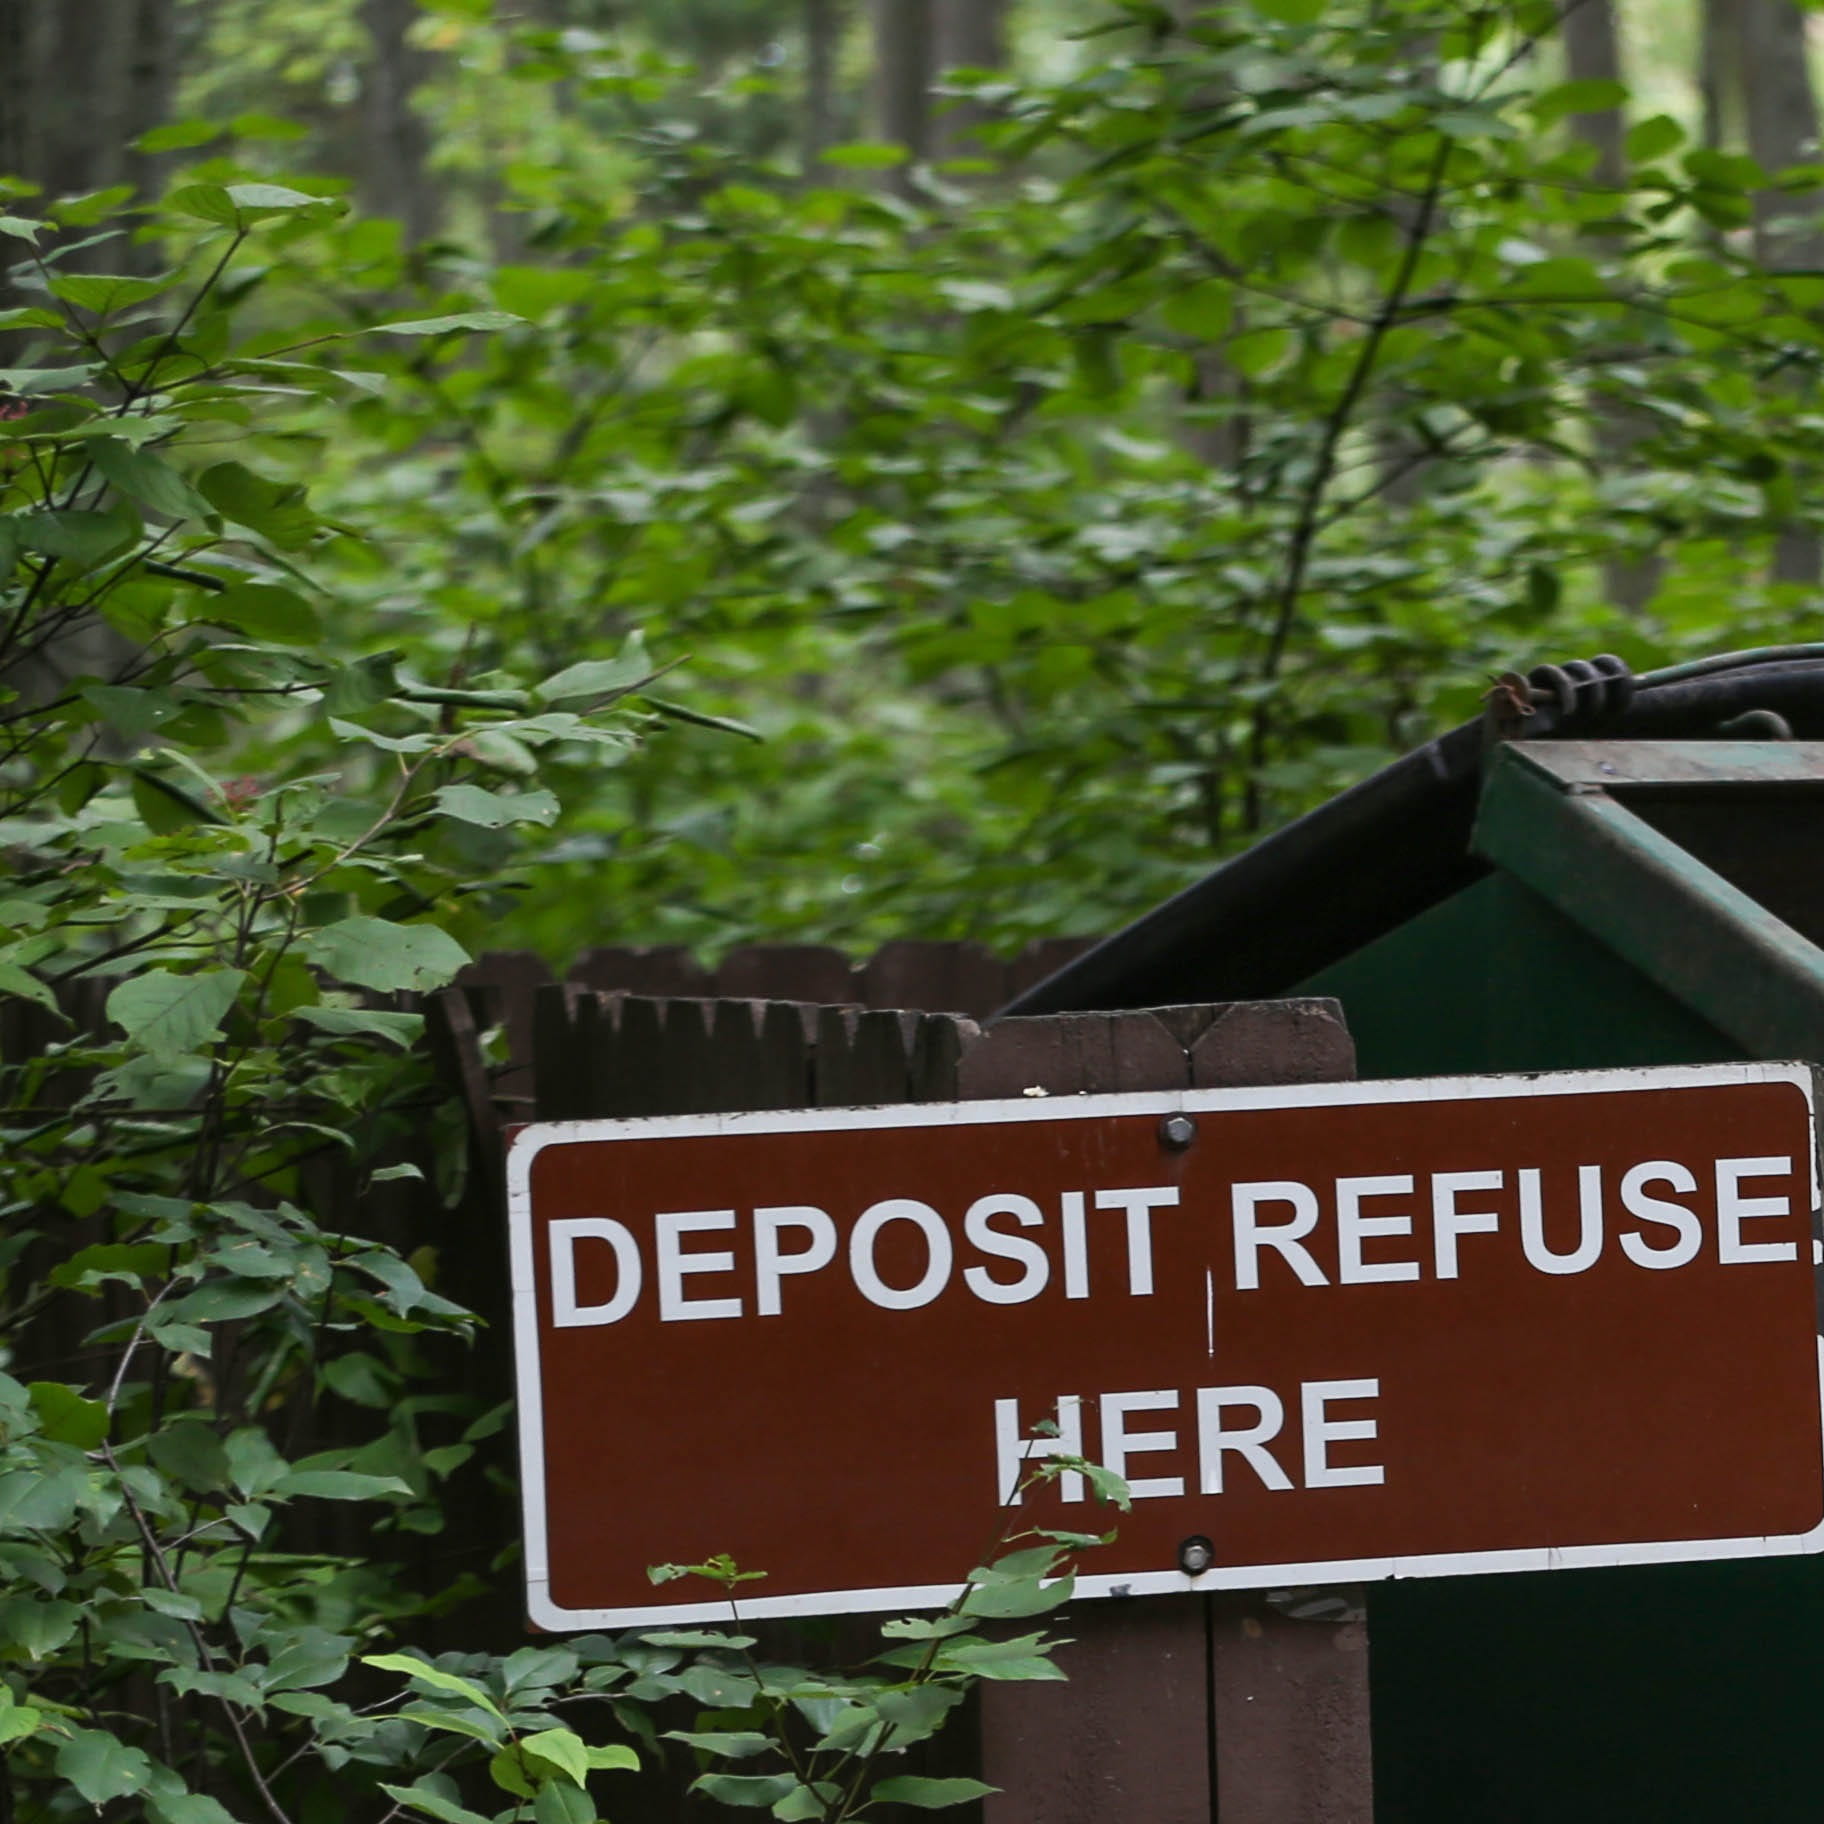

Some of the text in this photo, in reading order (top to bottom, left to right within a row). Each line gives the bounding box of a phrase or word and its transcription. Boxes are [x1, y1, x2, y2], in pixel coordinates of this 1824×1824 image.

[548, 1156, 1797, 1328] DEPOSIT REFUSE
[994, 1378, 1385, 1506] HERE
